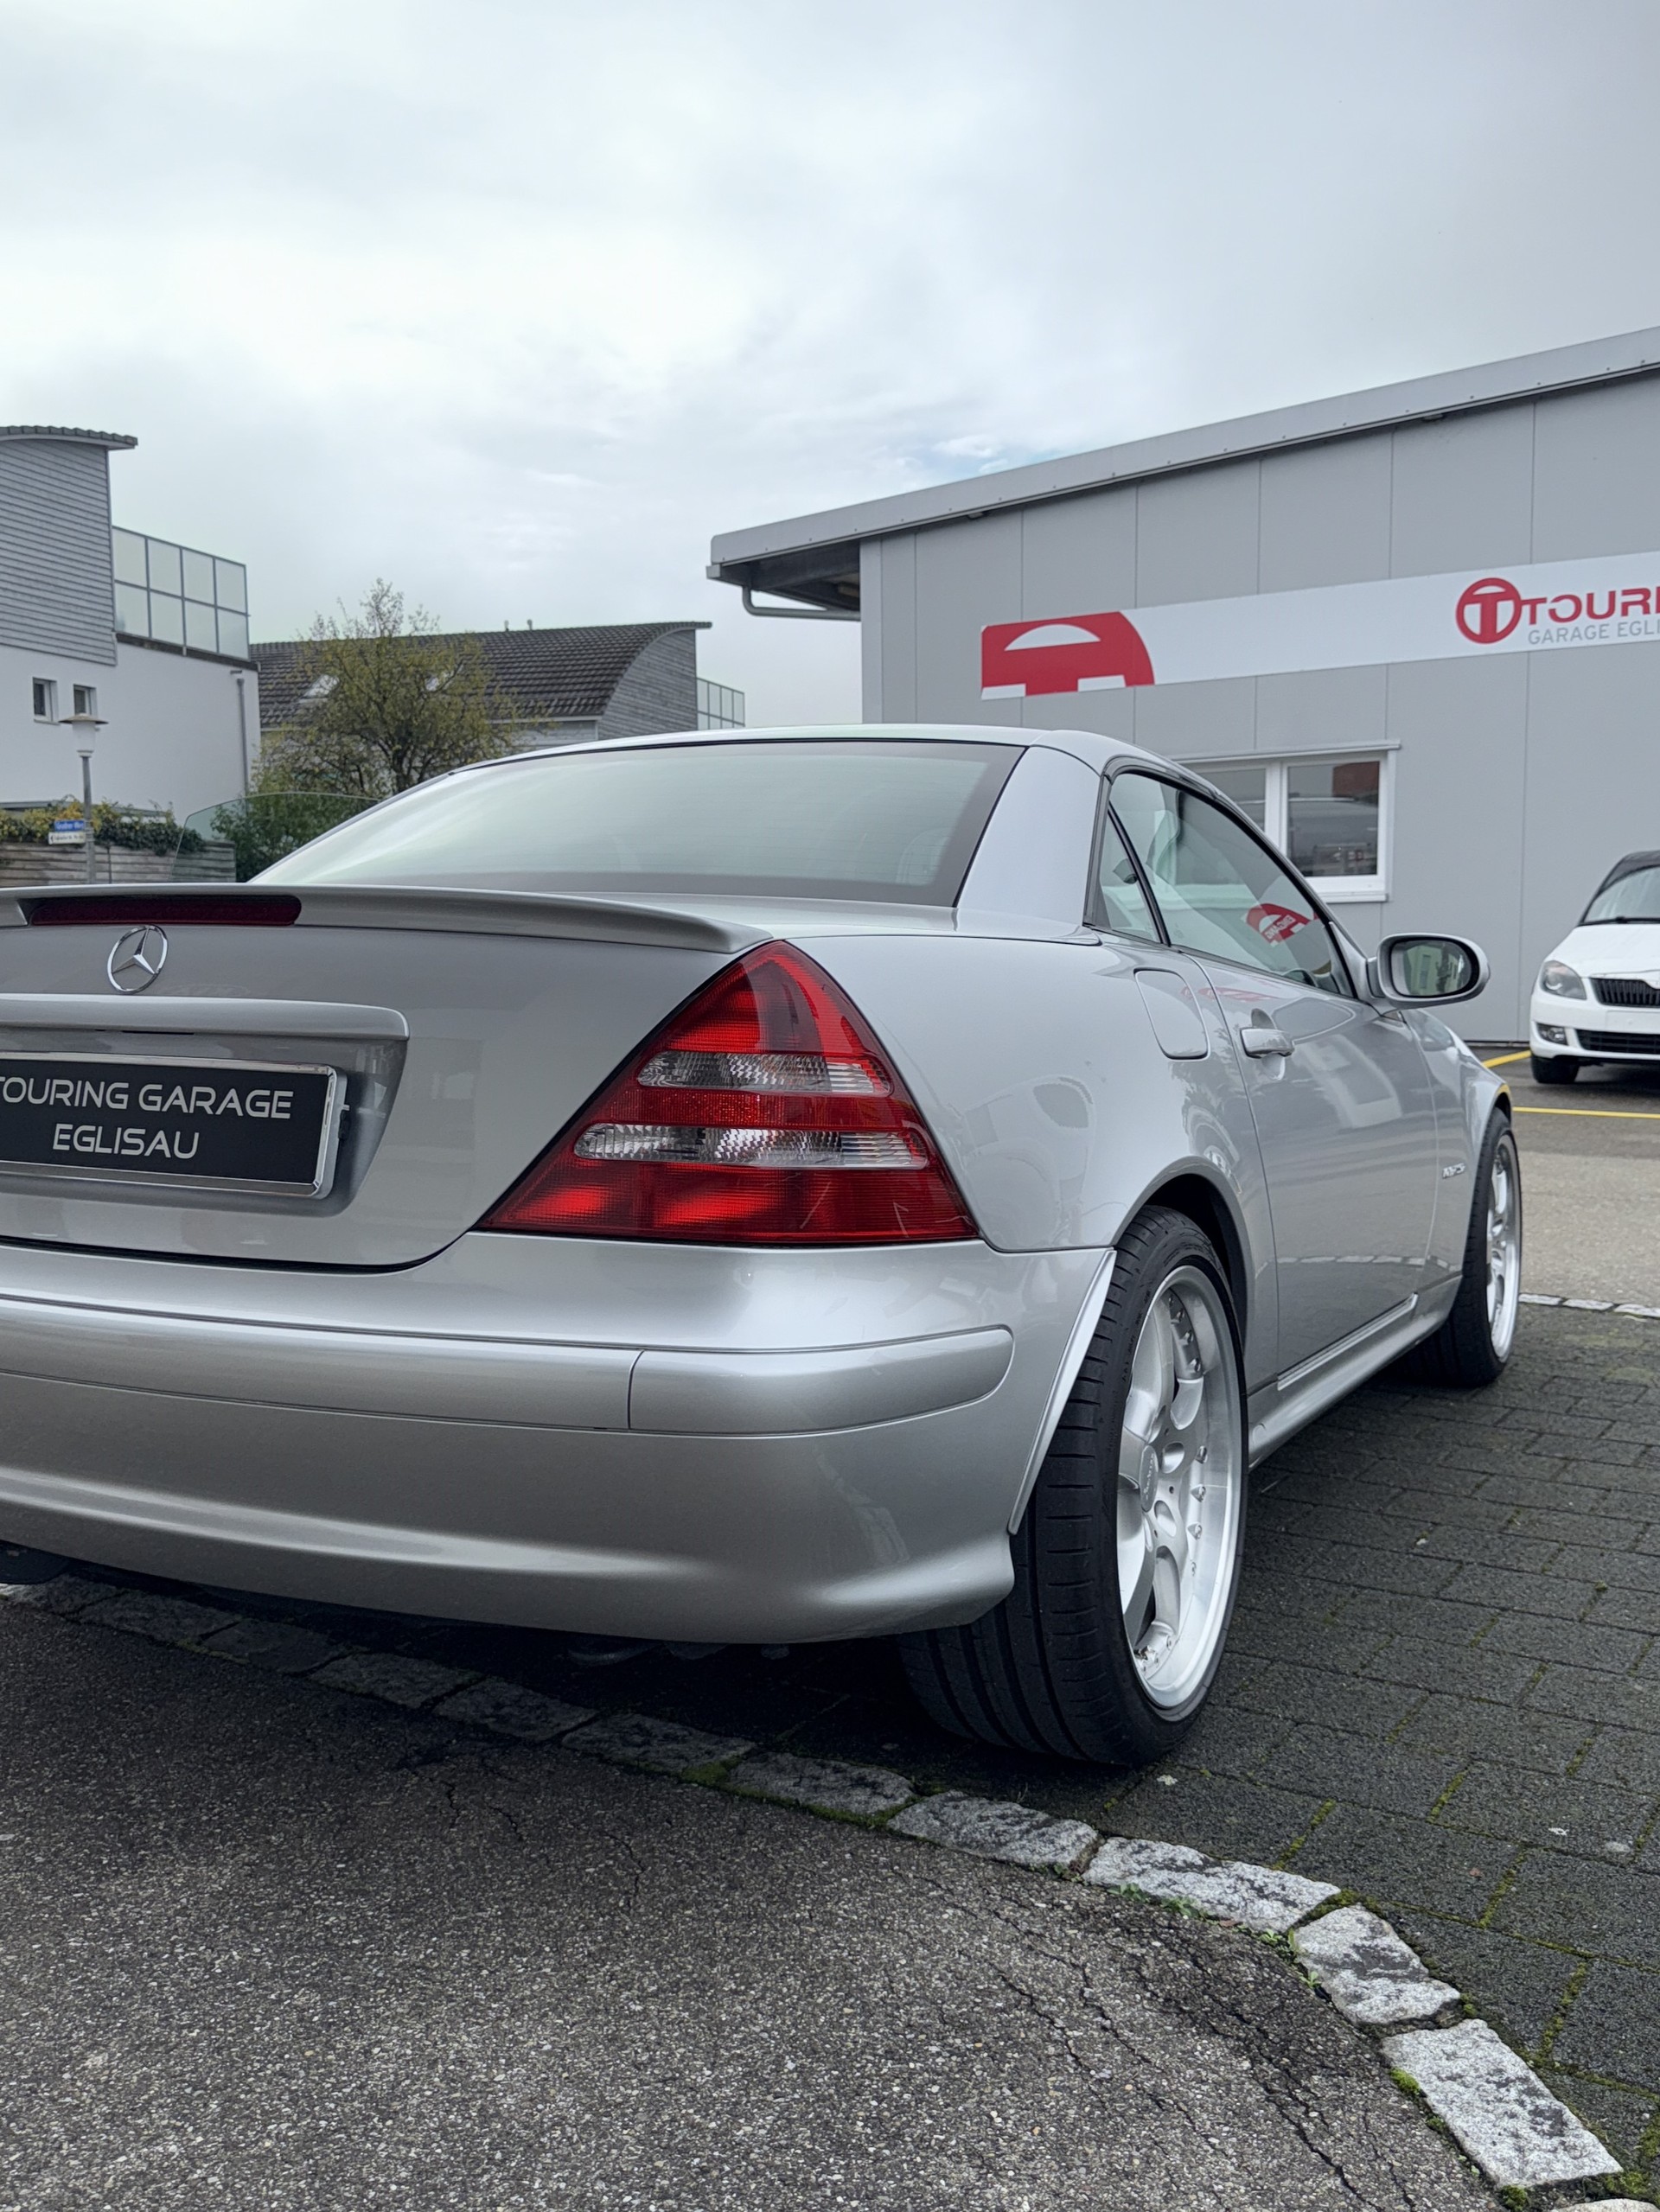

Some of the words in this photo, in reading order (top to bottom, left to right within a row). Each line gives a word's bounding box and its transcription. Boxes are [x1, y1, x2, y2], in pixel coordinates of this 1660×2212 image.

[1528, 623, 1610, 645] GARAGE
[138, 1084, 294, 1119] GARAGE
[53, 1123, 200, 1159] EGLISAU
